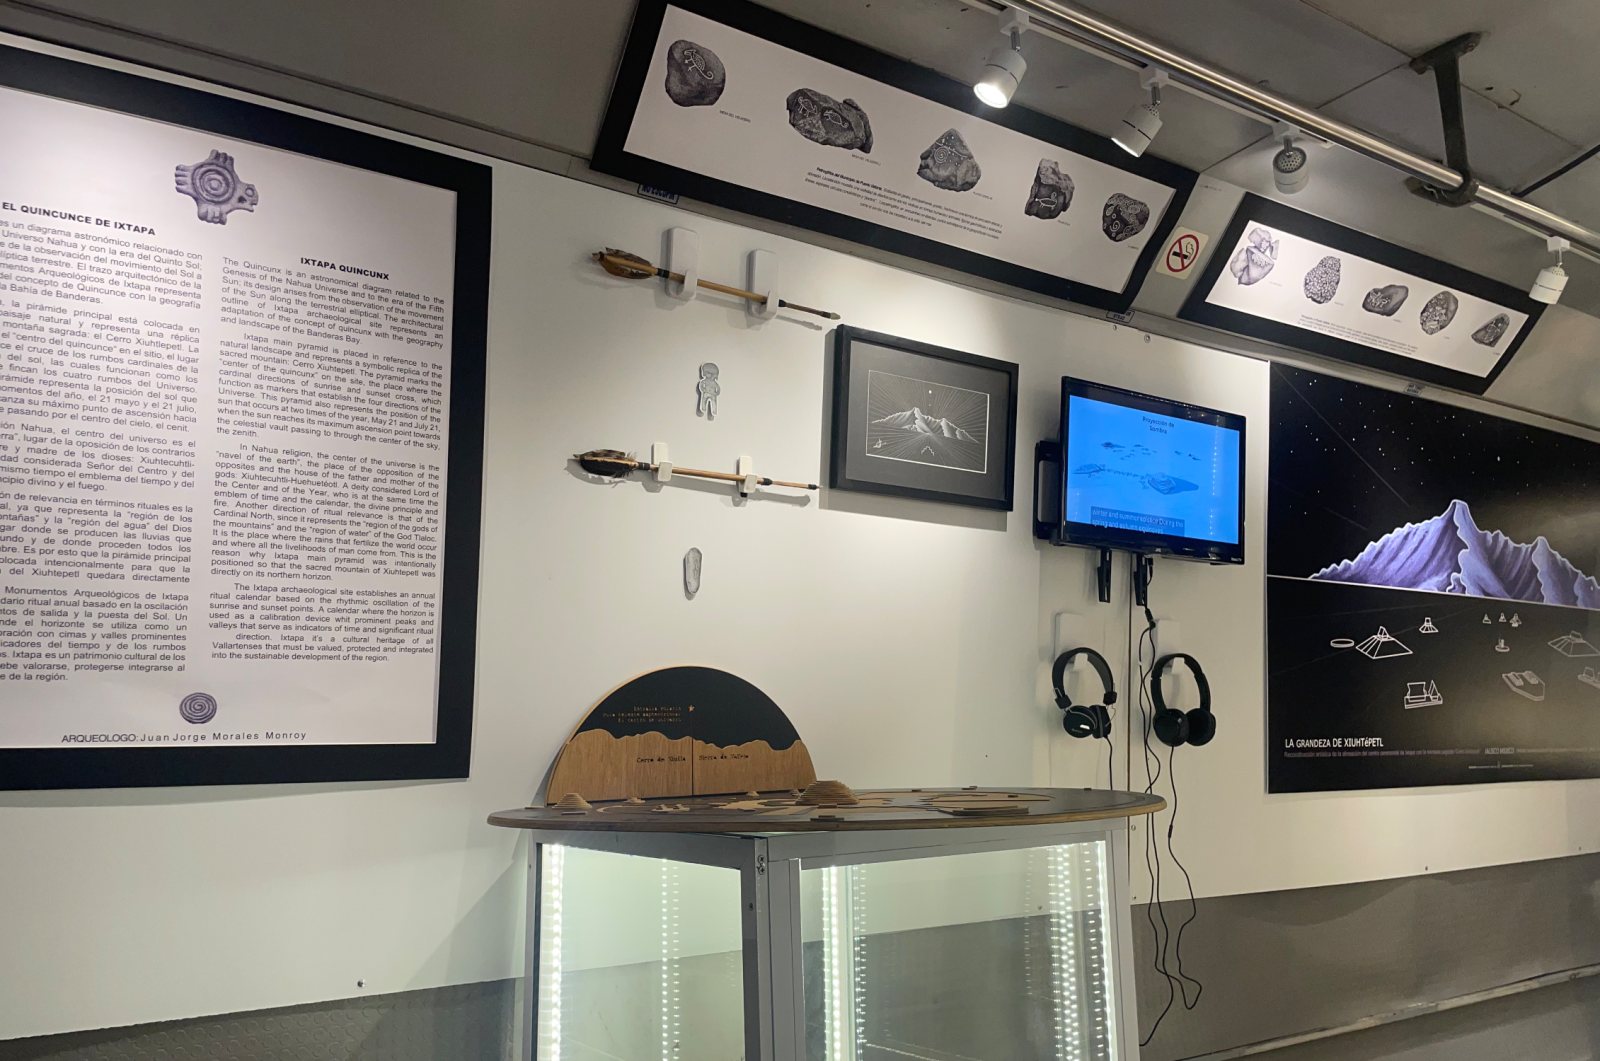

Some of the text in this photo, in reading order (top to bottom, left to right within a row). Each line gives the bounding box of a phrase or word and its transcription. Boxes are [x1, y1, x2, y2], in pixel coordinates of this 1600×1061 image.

[2, 202, 155, 235] EL QUINCUNCE DE IXTAPA
[300, 257, 389, 280] IXTAPA QUINCUNX
[172, 733, 206, 742] Jorge
[265, 731, 306, 740] Monroy
[1285, 739, 1294, 748] LA
[1296, 739, 1330, 747] GRANDEZA
[1333, 738, 1342, 747] DE
